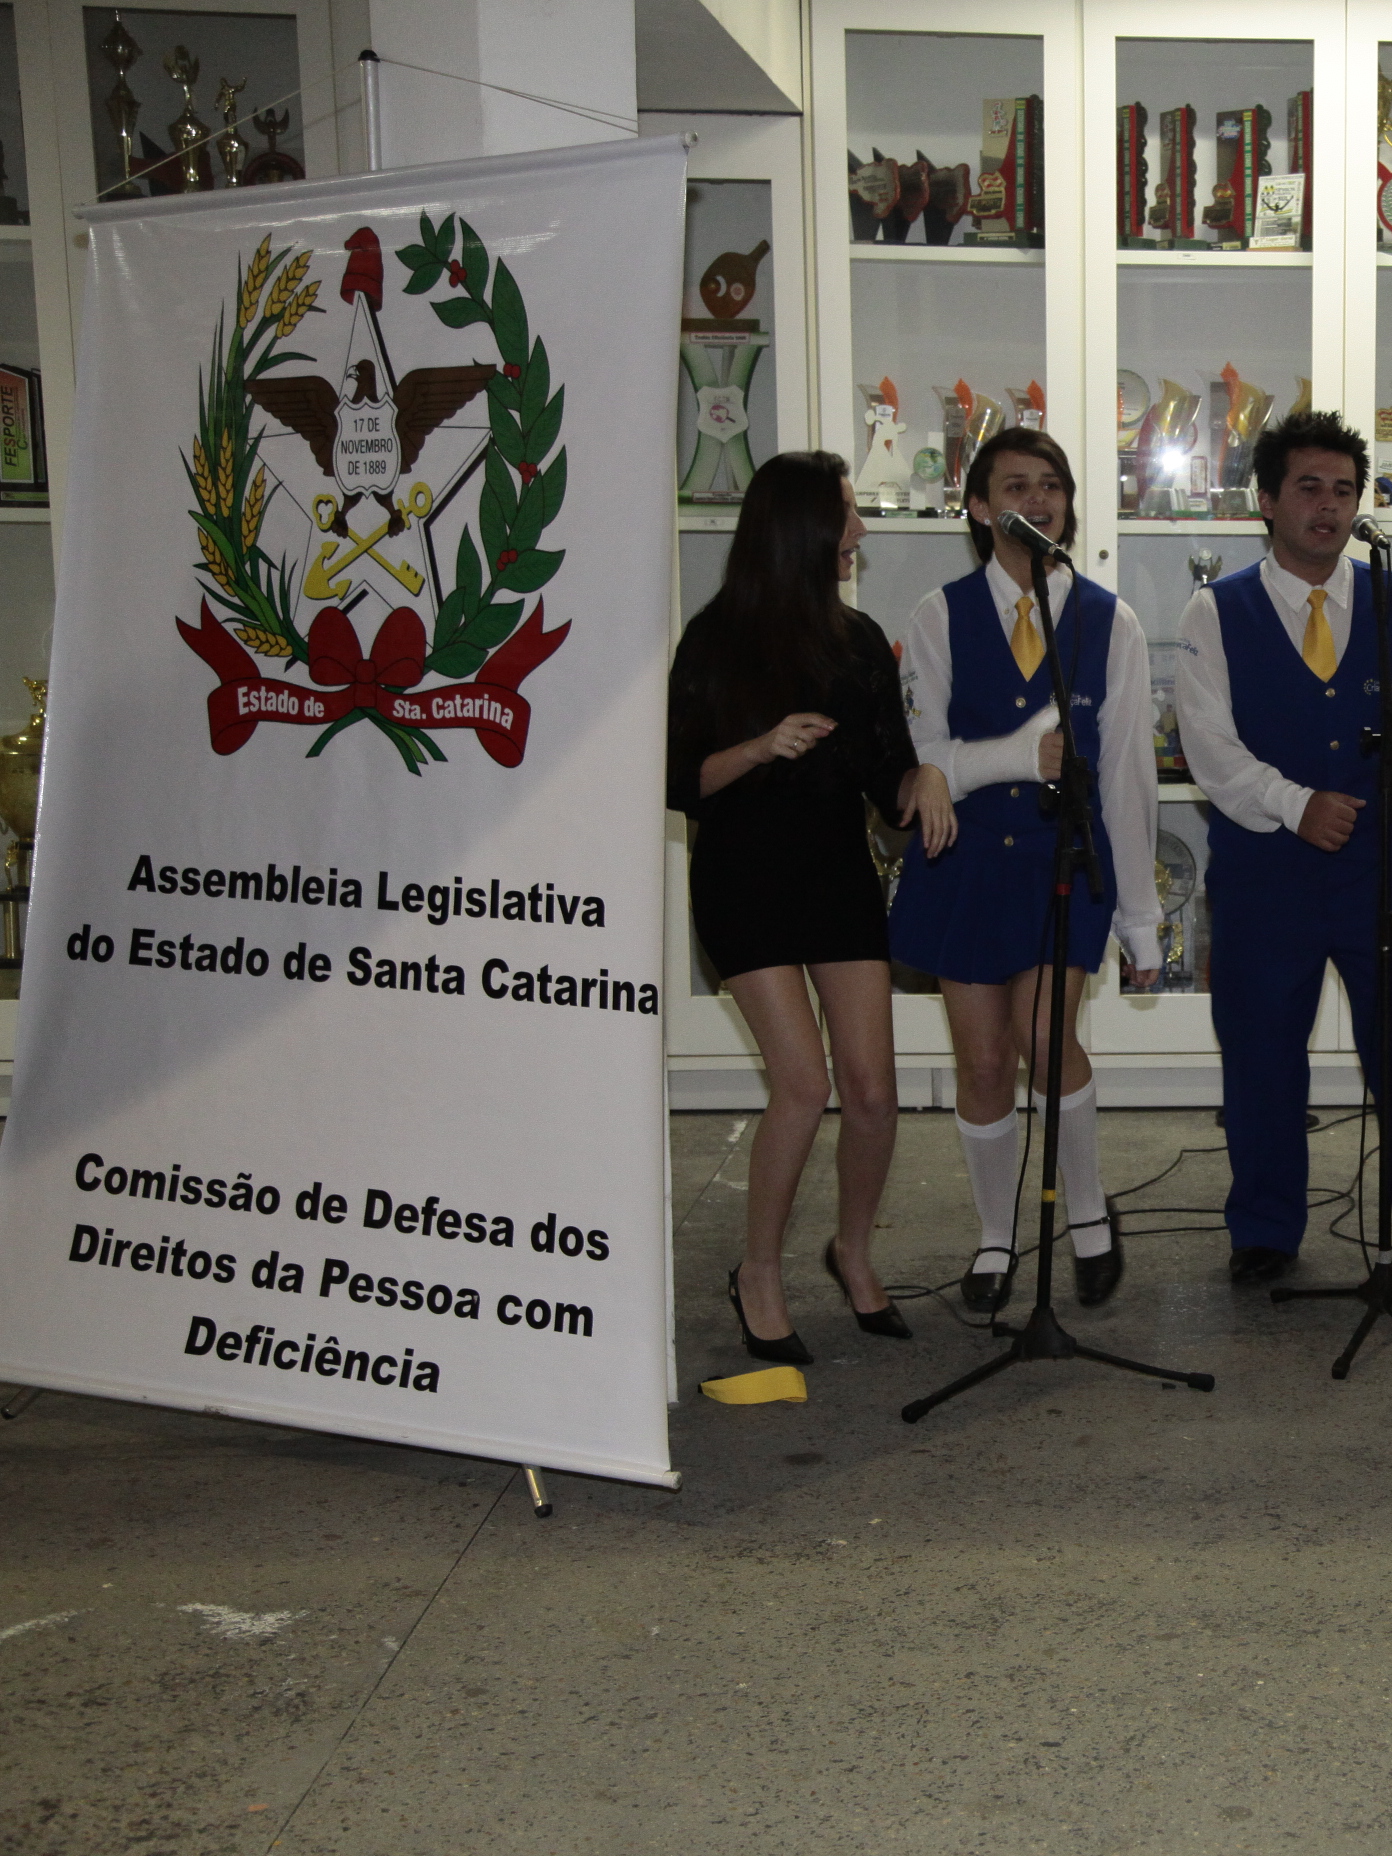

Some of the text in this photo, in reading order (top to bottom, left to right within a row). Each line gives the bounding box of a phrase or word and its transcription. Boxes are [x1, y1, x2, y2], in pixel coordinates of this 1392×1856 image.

[1, 385, 17, 467] FESPORTE
[341, 438, 393, 454] NOVEMBRO
[354, 417, 380, 433] 17 DE
[348, 460, 387, 475] DE 1889
[237, 685, 514, 731] Estado de Sta. Catarina
[127, 854, 606, 927] Assembleia Legislativa
[66, 924, 660, 1016] do Estado de Santa Catarina
[75, 1152, 611, 1262] Comissão de Defesa dos
[68, 1223, 594, 1338] Direitos da Pessoa com
[184, 1315, 441, 1393] Deficiência
